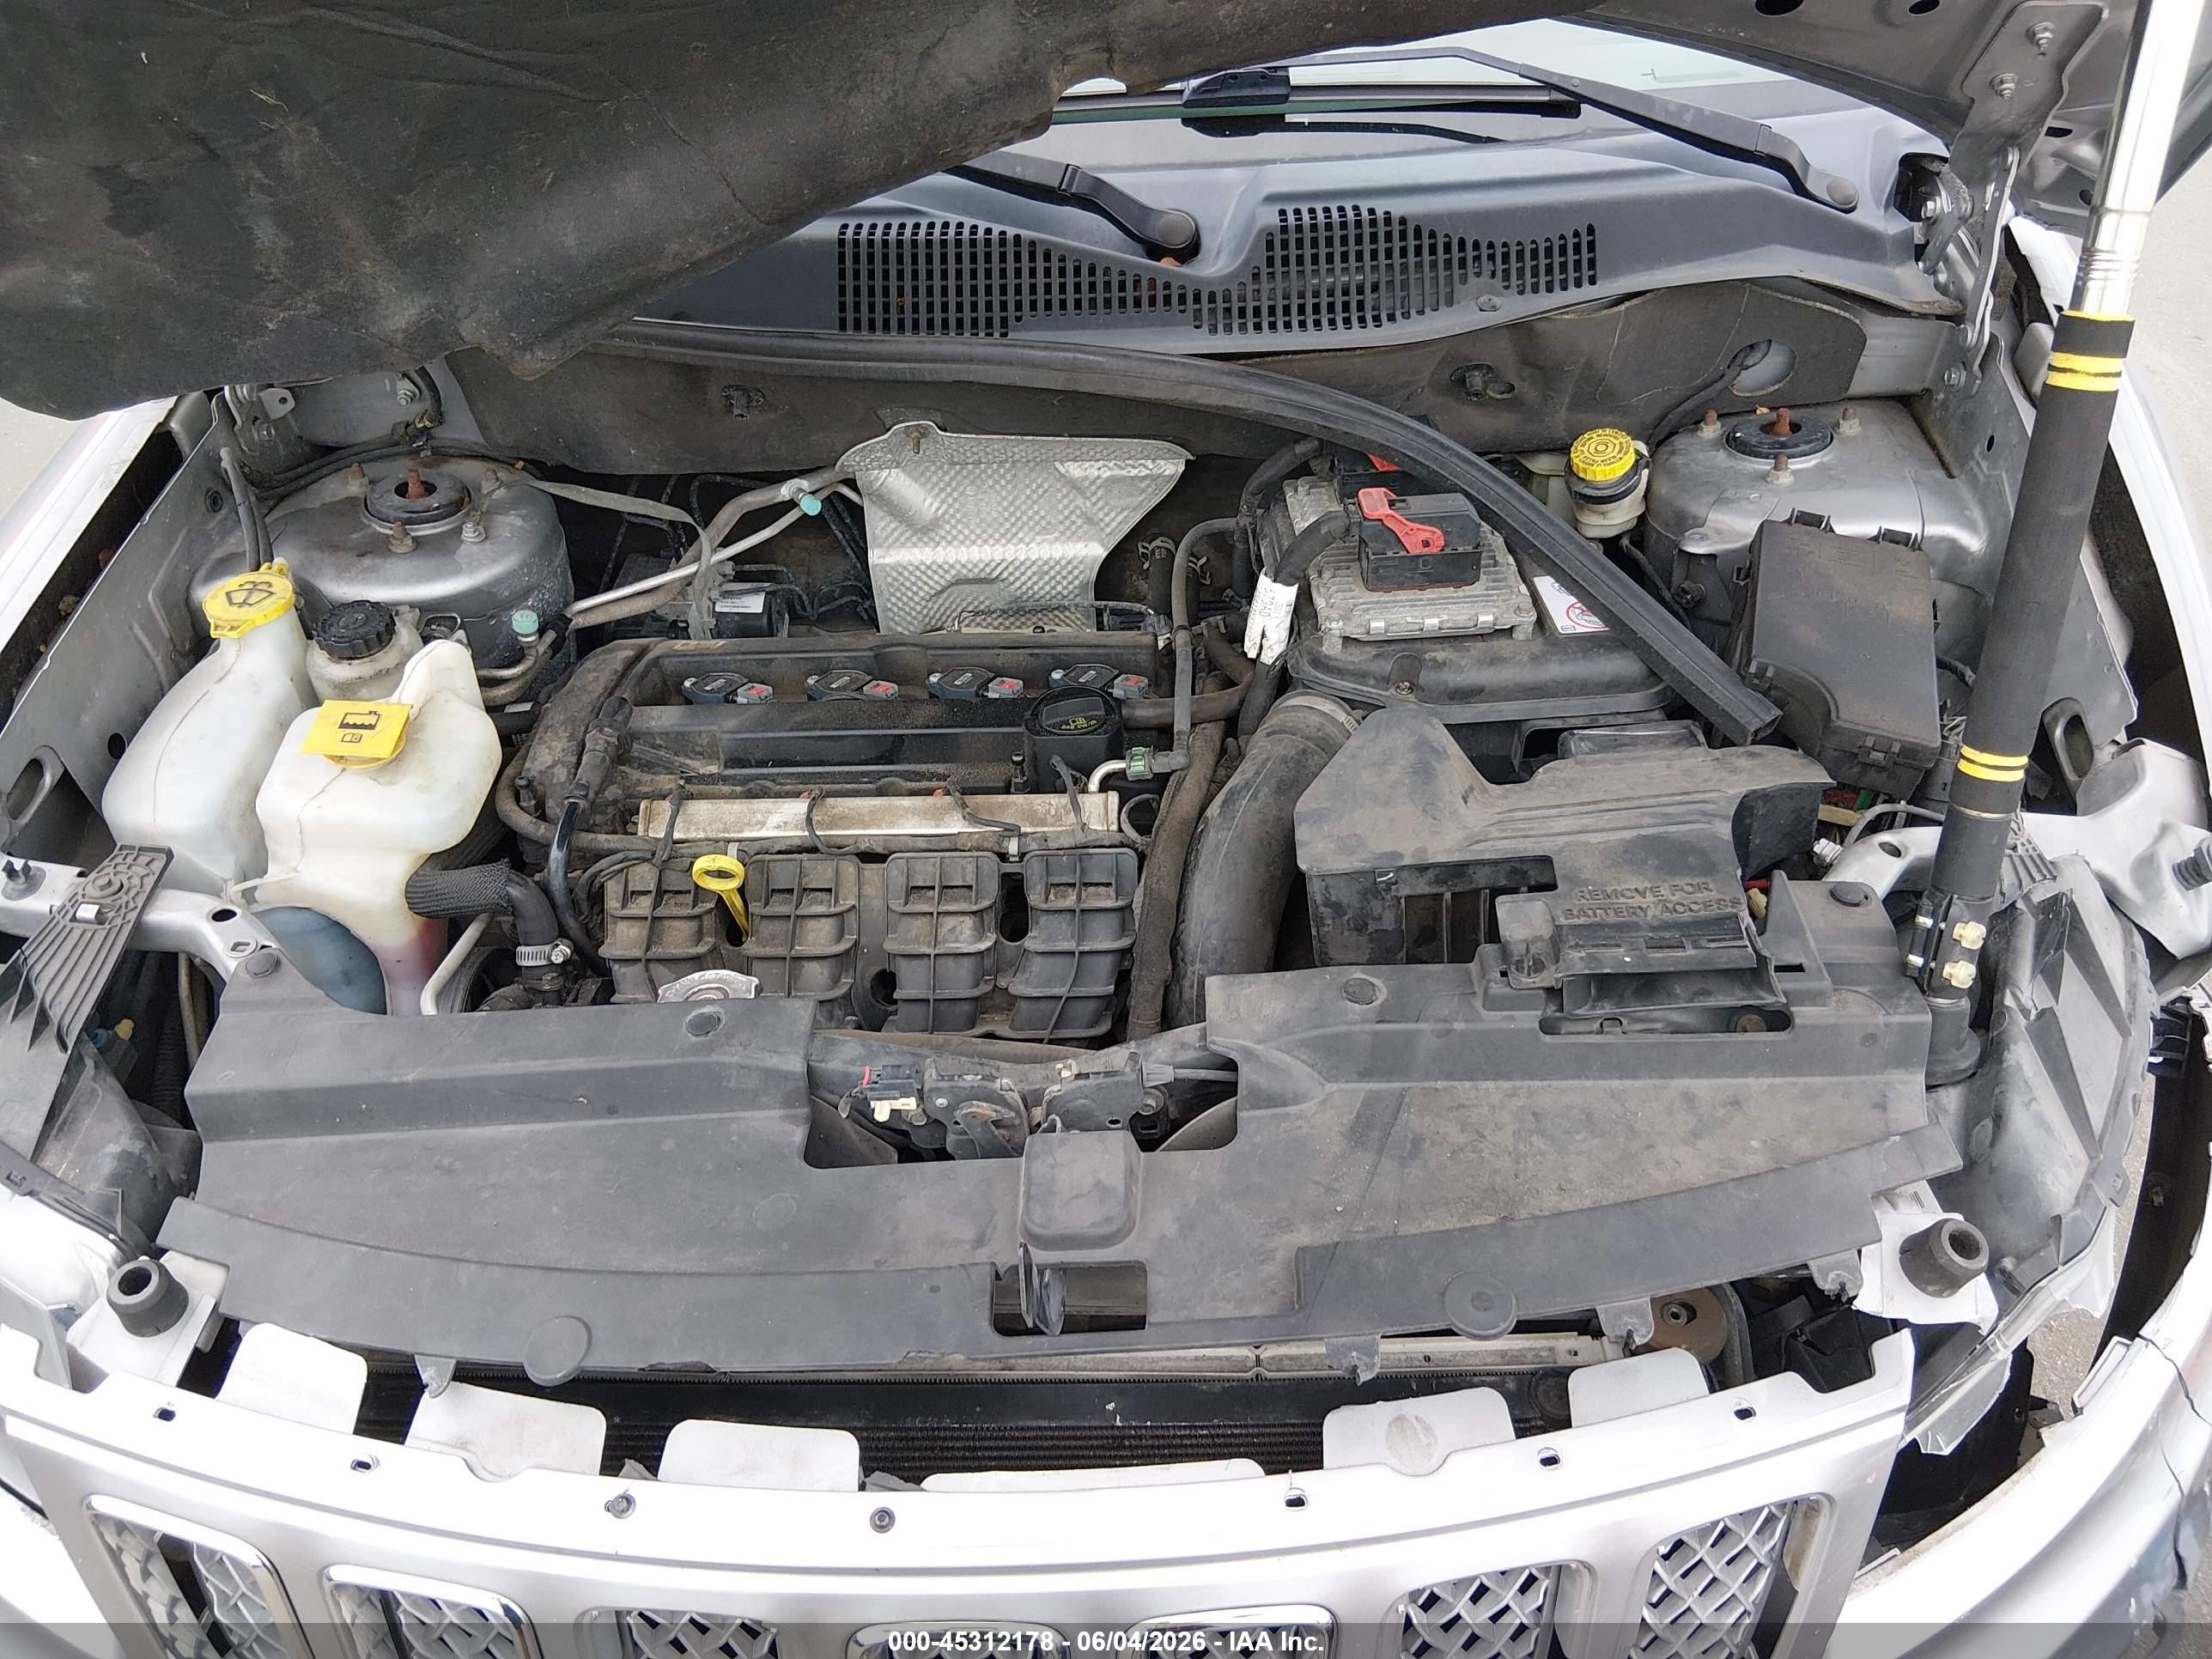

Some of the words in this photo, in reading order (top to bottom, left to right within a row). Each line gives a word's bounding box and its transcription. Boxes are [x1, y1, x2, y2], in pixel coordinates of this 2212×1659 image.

[1577, 884, 1664, 902] REMOVE
[1672, 880, 1714, 896] FOR
[1561, 904, 1651, 921] BATTERY
[1660, 896, 1747, 917] ACCESS
